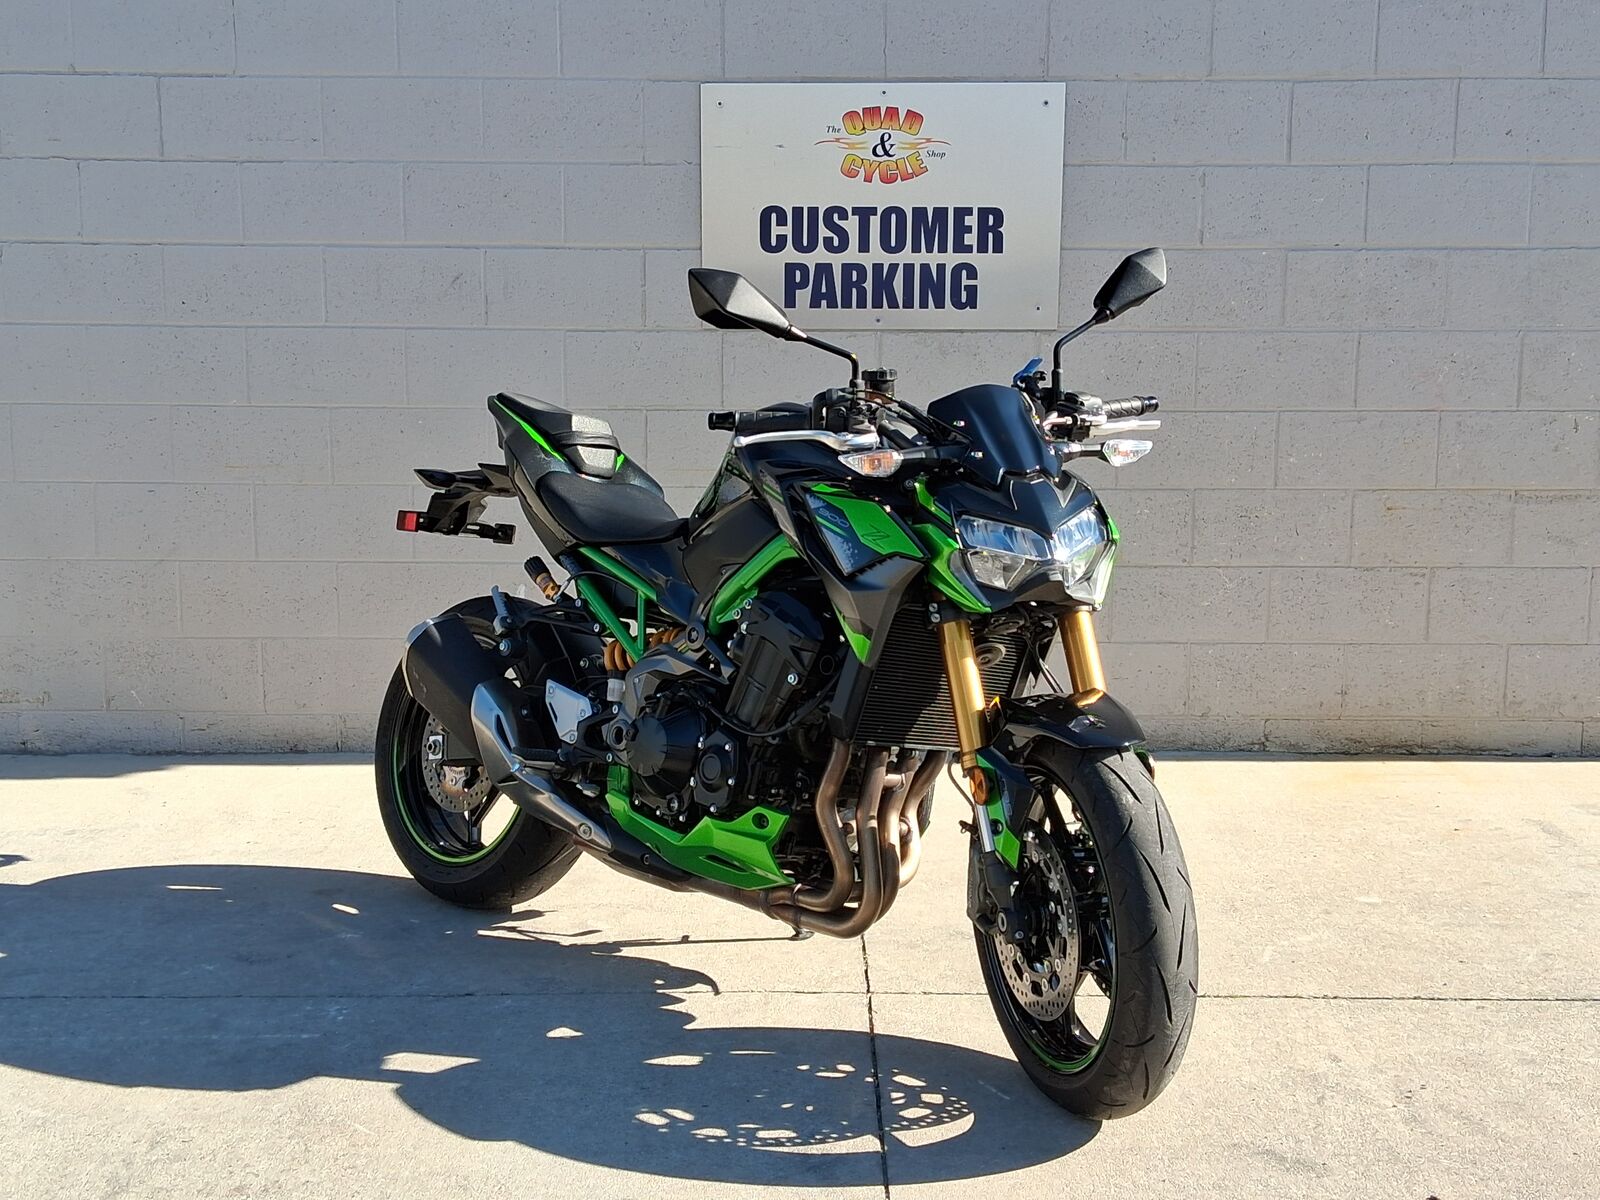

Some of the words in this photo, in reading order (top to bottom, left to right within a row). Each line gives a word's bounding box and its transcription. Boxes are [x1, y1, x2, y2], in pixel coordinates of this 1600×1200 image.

[826, 125, 842, 134] The
[841, 106, 924, 136] QUAD
[871, 131, 897, 158] &
[925, 150, 946, 160] Shop
[840, 151, 929, 184] CYCLE
[759, 206, 1004, 254] CUSTOMER
[784, 262, 978, 310] PARKING
[818, 507, 850, 528] 900
